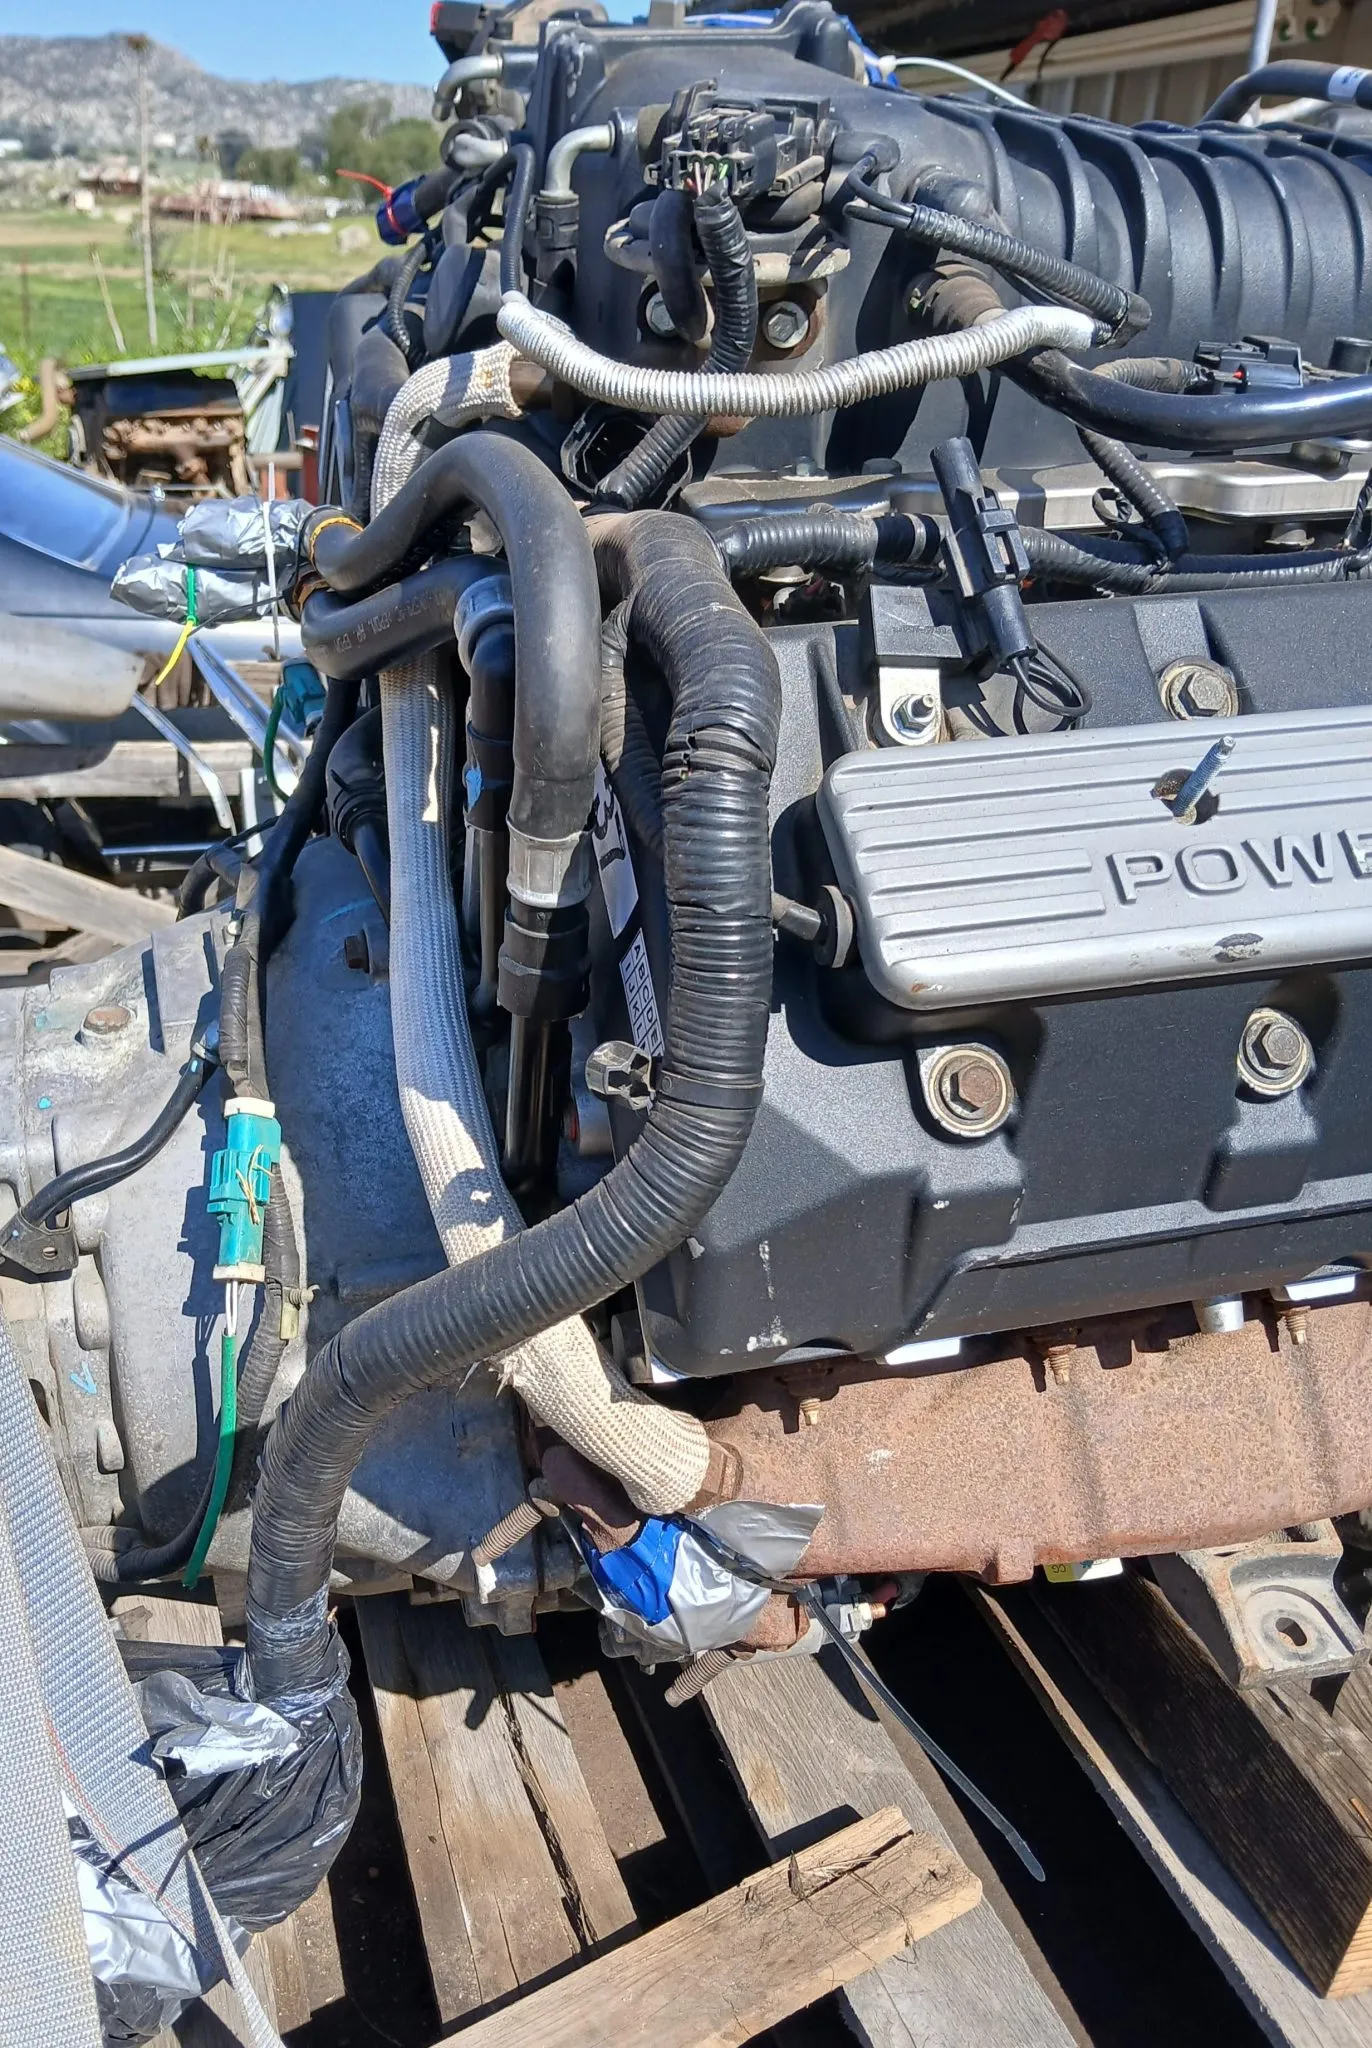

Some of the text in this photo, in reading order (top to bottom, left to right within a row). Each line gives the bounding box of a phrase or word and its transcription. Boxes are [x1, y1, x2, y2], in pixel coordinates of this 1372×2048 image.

[628, 982, 635, 993] J
[632, 1001, 640, 1019] K
[636, 1023, 642, 1040] L
[634, 943, 658, 1046] A B C D E
[1051, 1563, 1067, 1574] CG
